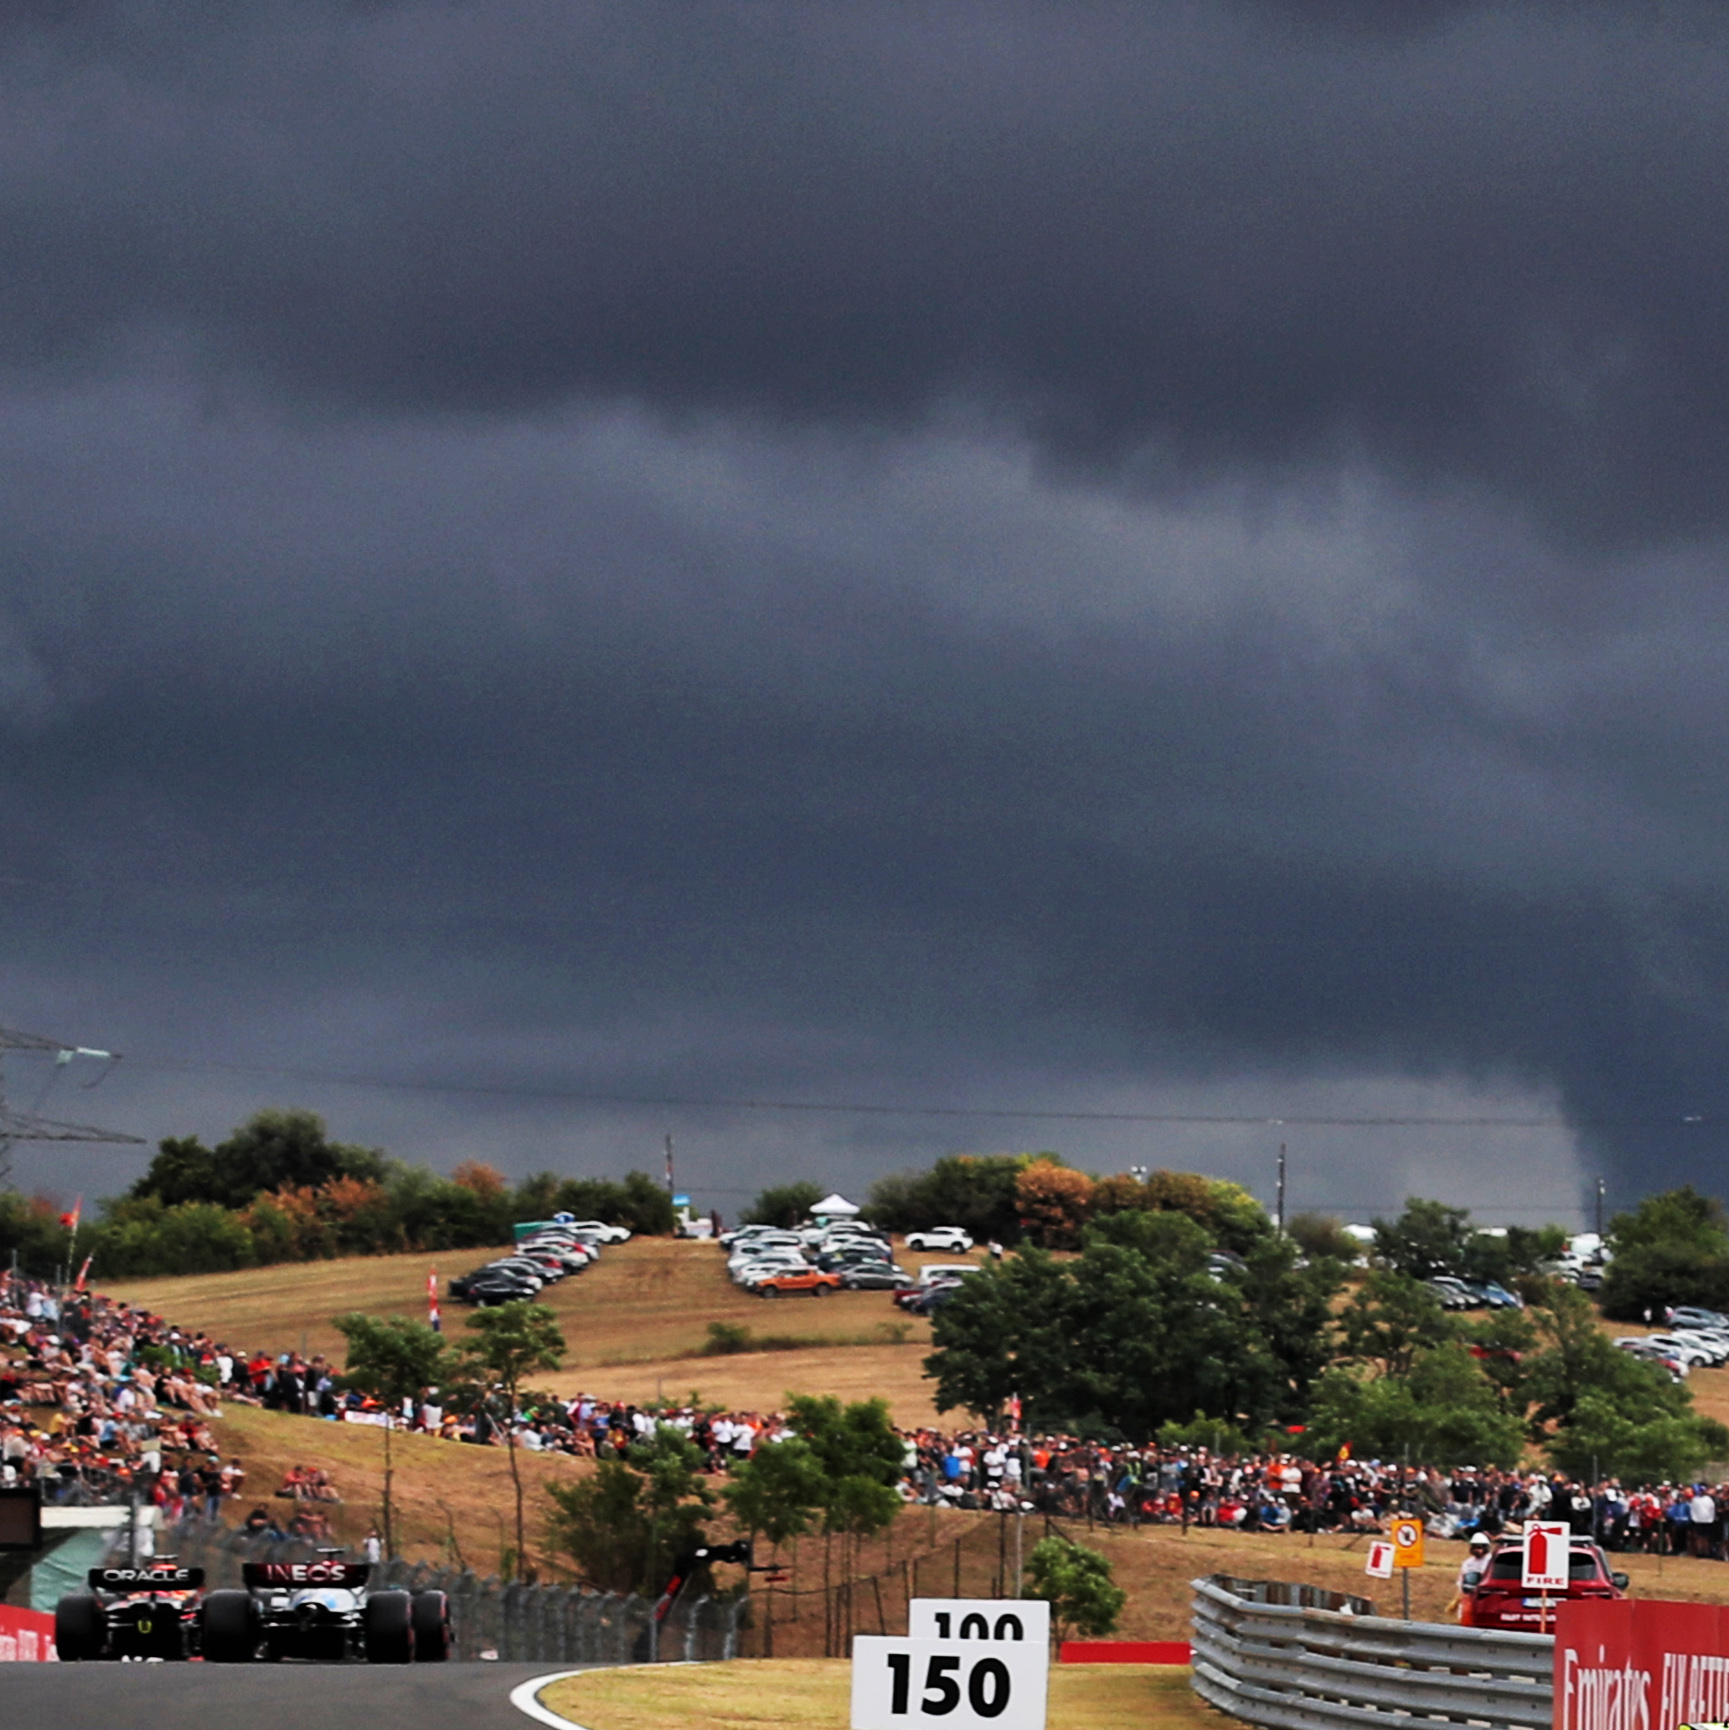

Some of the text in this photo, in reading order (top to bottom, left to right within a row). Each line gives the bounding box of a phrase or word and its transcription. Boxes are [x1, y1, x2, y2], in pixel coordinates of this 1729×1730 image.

[103, 1568, 190, 1582] ORACLE
[267, 1564, 346, 1581] INEOS
[1526, 1576, 1565, 1587] FIRE
[934, 1612, 1024, 1640] 100
[887, 1653, 1011, 1718] 150
